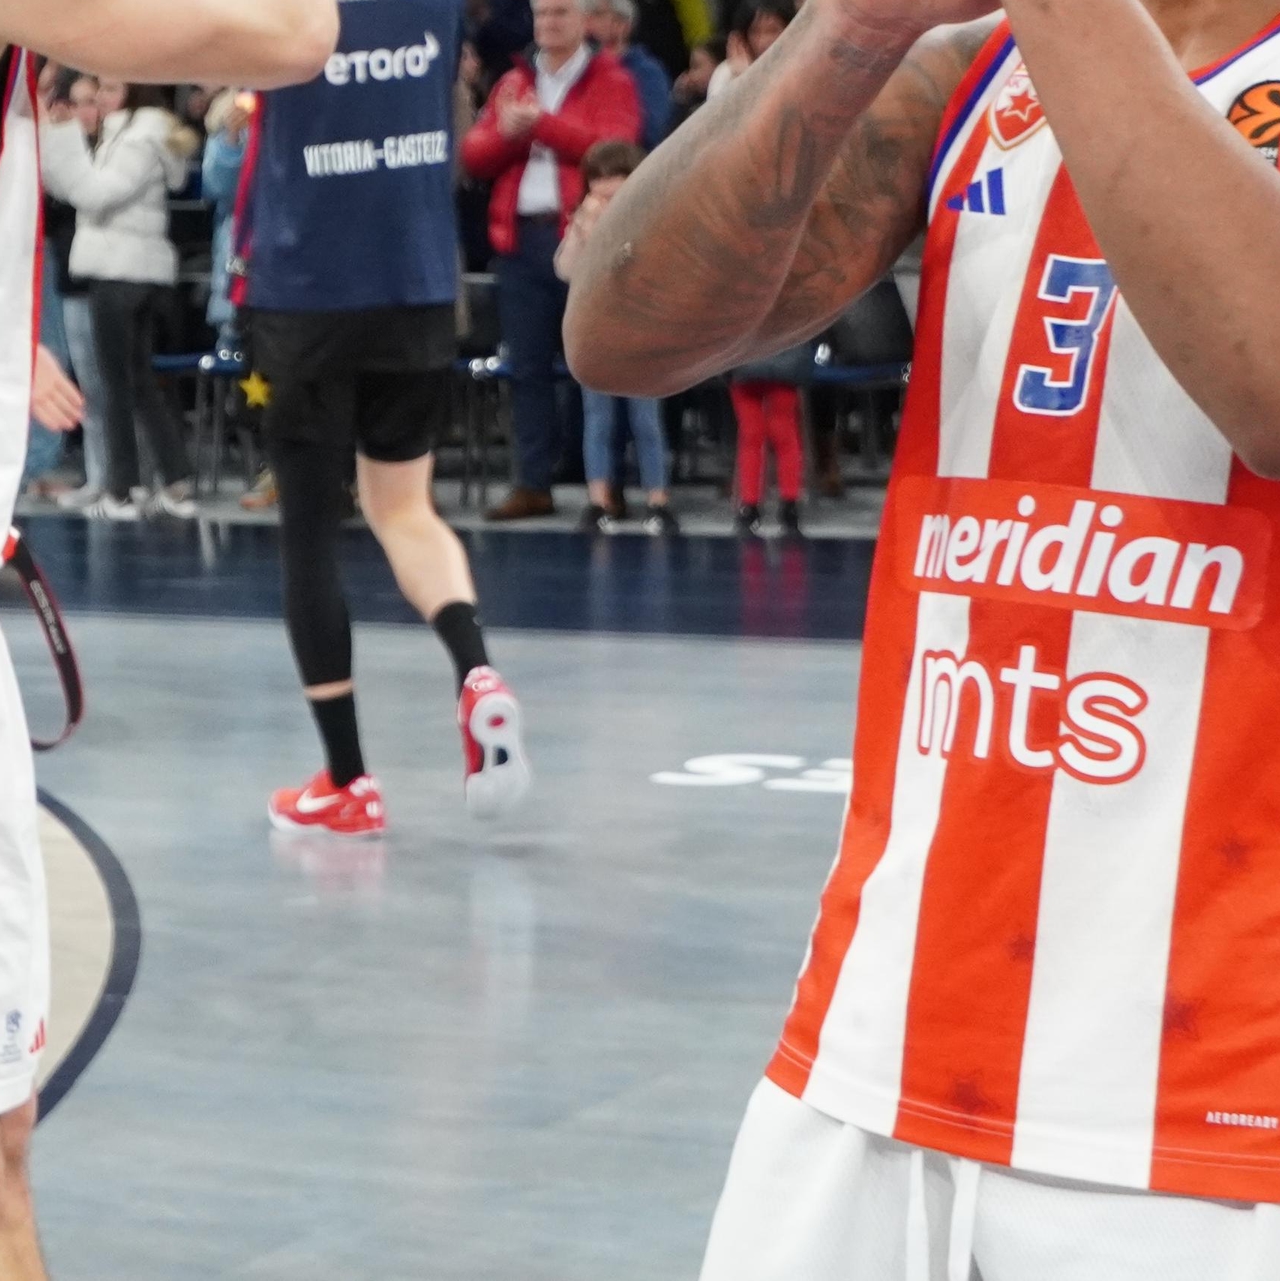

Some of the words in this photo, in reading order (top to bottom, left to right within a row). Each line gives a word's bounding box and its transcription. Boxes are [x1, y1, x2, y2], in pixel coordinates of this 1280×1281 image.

[303, 129, 449, 178] VITORIA-GASTEIZ
[1011, 253, 1121, 417] 3
[913, 494, 1245, 615] meridian
[918, 642, 1150, 786] mts
